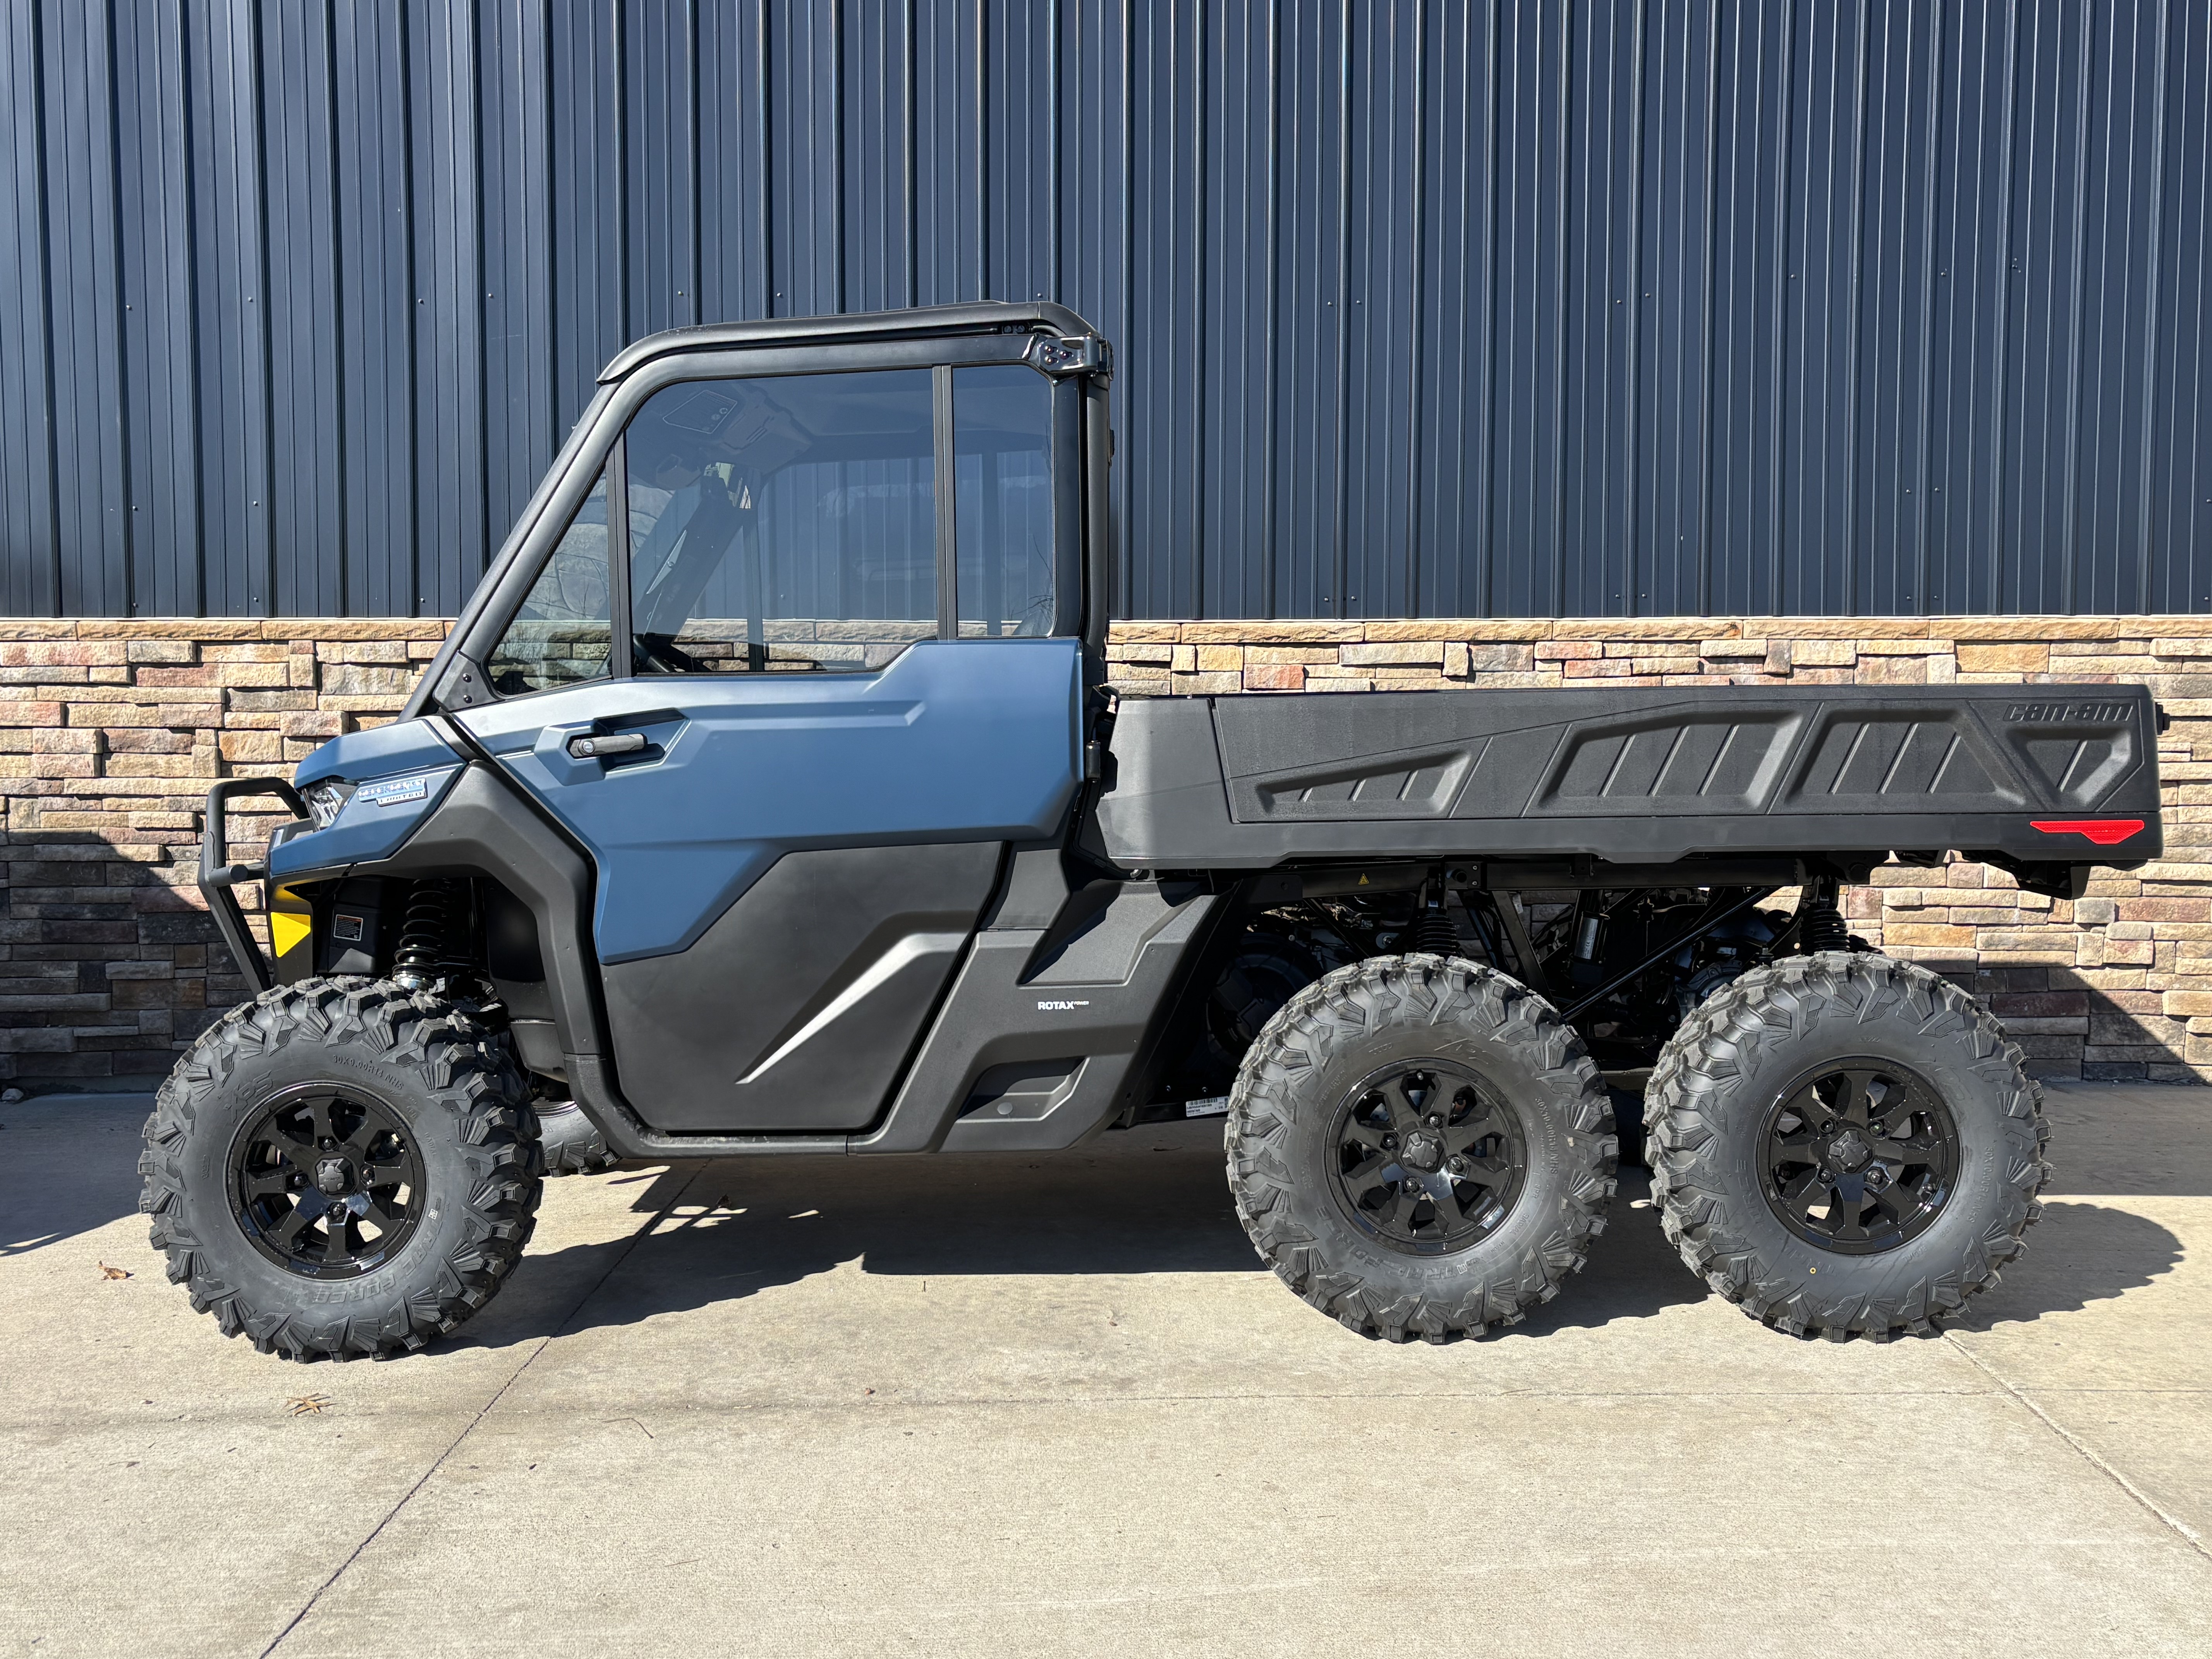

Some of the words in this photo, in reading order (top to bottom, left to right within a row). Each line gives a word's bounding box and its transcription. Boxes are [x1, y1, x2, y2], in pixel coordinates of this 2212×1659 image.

[1037, 1001, 1074, 1010] ROTAX
[385, 1073, 404, 1090] NHS
[1550, 1153, 1559, 1175] NHS
